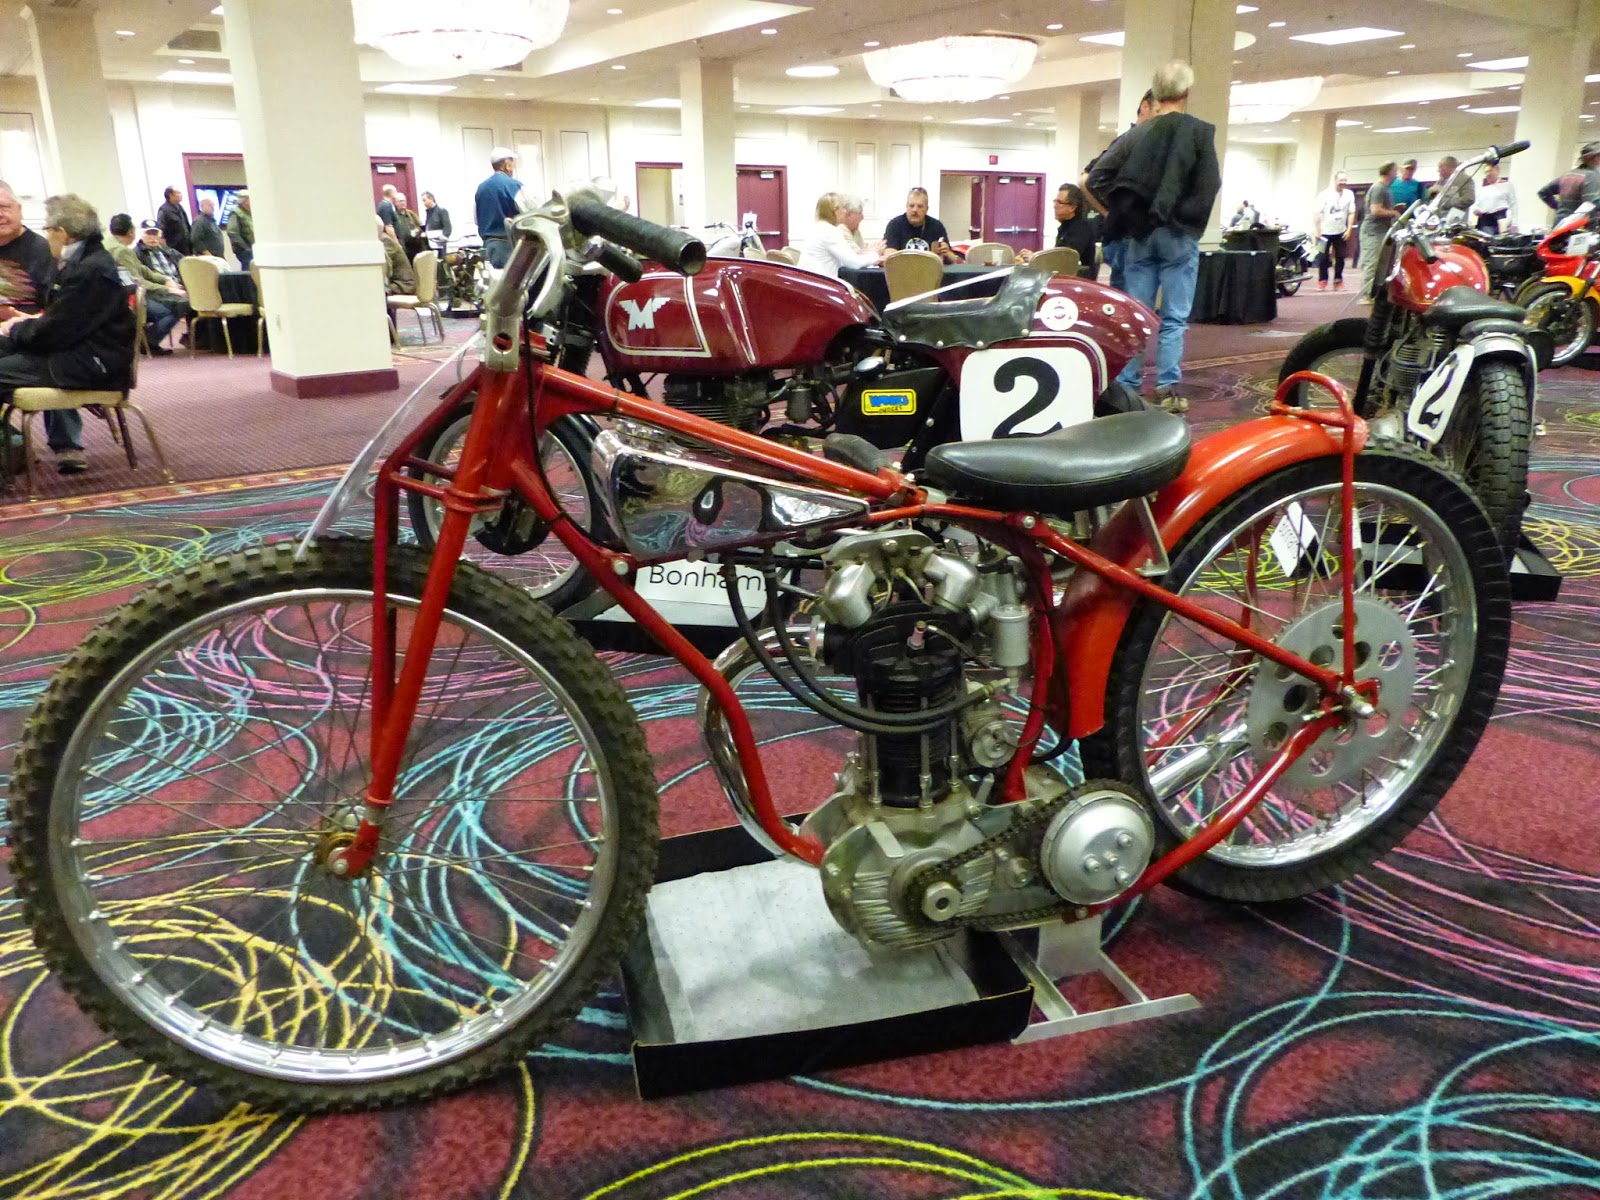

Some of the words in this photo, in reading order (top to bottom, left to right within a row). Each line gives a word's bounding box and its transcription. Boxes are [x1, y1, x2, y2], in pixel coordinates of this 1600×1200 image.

[992, 356, 1063, 439] 2
[1418, 353, 1460, 430] 2
[649, 564, 767, 592] Bonhm
